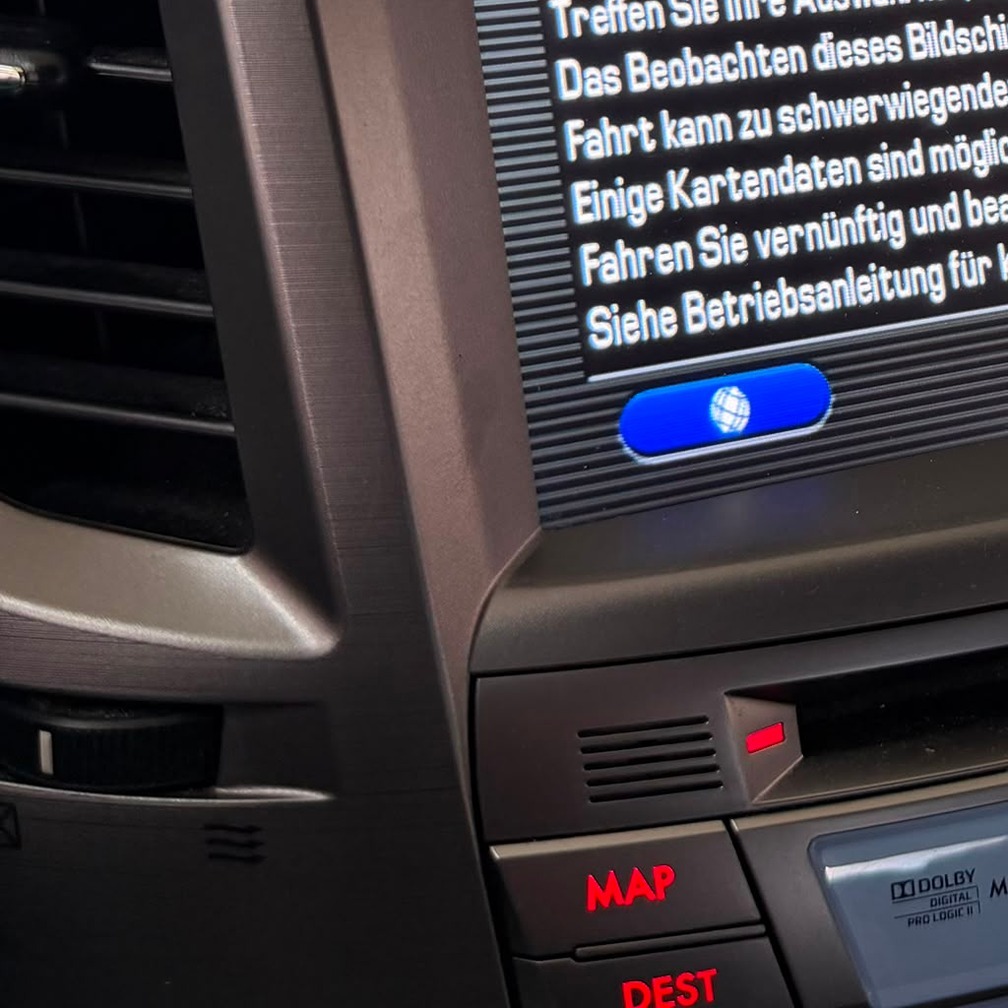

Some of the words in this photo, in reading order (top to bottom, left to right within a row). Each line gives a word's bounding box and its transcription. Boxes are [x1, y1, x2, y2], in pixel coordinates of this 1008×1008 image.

[555, 57, 622, 101] Das
[624, 41, 808, 93] Beobachten
[812, 31, 904, 72] dieses
[564, 116, 657, 162] Fahrt
[661, 108, 733, 150] kann
[738, 105, 773, 141] zu
[570, 176, 665, 227] Einige
[667, 154, 863, 211] Kartendaten
[866, 136, 926, 184] sind
[579, 238, 694, 287] Fahren
[695, 222, 749, 270] Sie
[753, 202, 906, 259] vernünftig
[909, 191, 963, 234] und
[586, 295, 678, 350] Siehe
[681, 263, 946, 337] Betriebsanleitung
[948, 250, 993, 289] für
[585, 863, 676, 912] MAP
[918, 868, 976, 893] DOLBY
[930, 892, 972, 908] DIGITAL
[907, 916, 930, 928] PRO
[933, 907, 965, 922] LOGIC
[966, 905, 974, 917] II
[621, 968, 718, 1008] DEST
